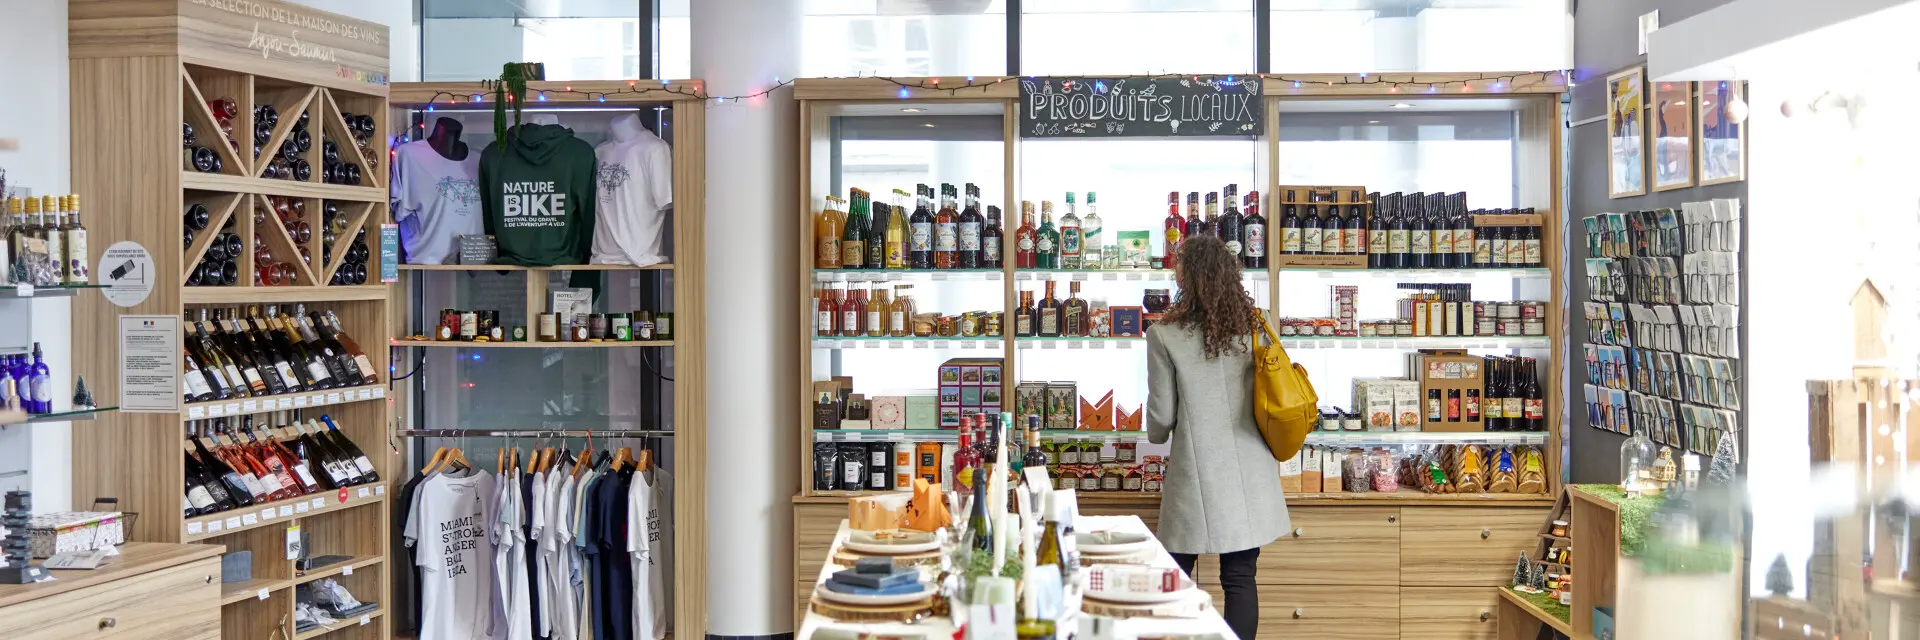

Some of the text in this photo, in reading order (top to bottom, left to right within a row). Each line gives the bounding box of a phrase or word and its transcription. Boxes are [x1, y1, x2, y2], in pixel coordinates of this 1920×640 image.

[271, 8, 285, 22] DE
[287, 11, 300, 26] LA
[302, 15, 340, 34] MAISON
[341, 23, 358, 39] DES
[360, 28, 380, 44] VINS
[1029, 89, 1254, 122] PRODUiTS LOCAUX
[503, 181, 555, 194] NATURE
[503, 193, 566, 217] BIKE
[508, 197, 517, 205] IS
[440, 516, 473, 532] MIAMI
